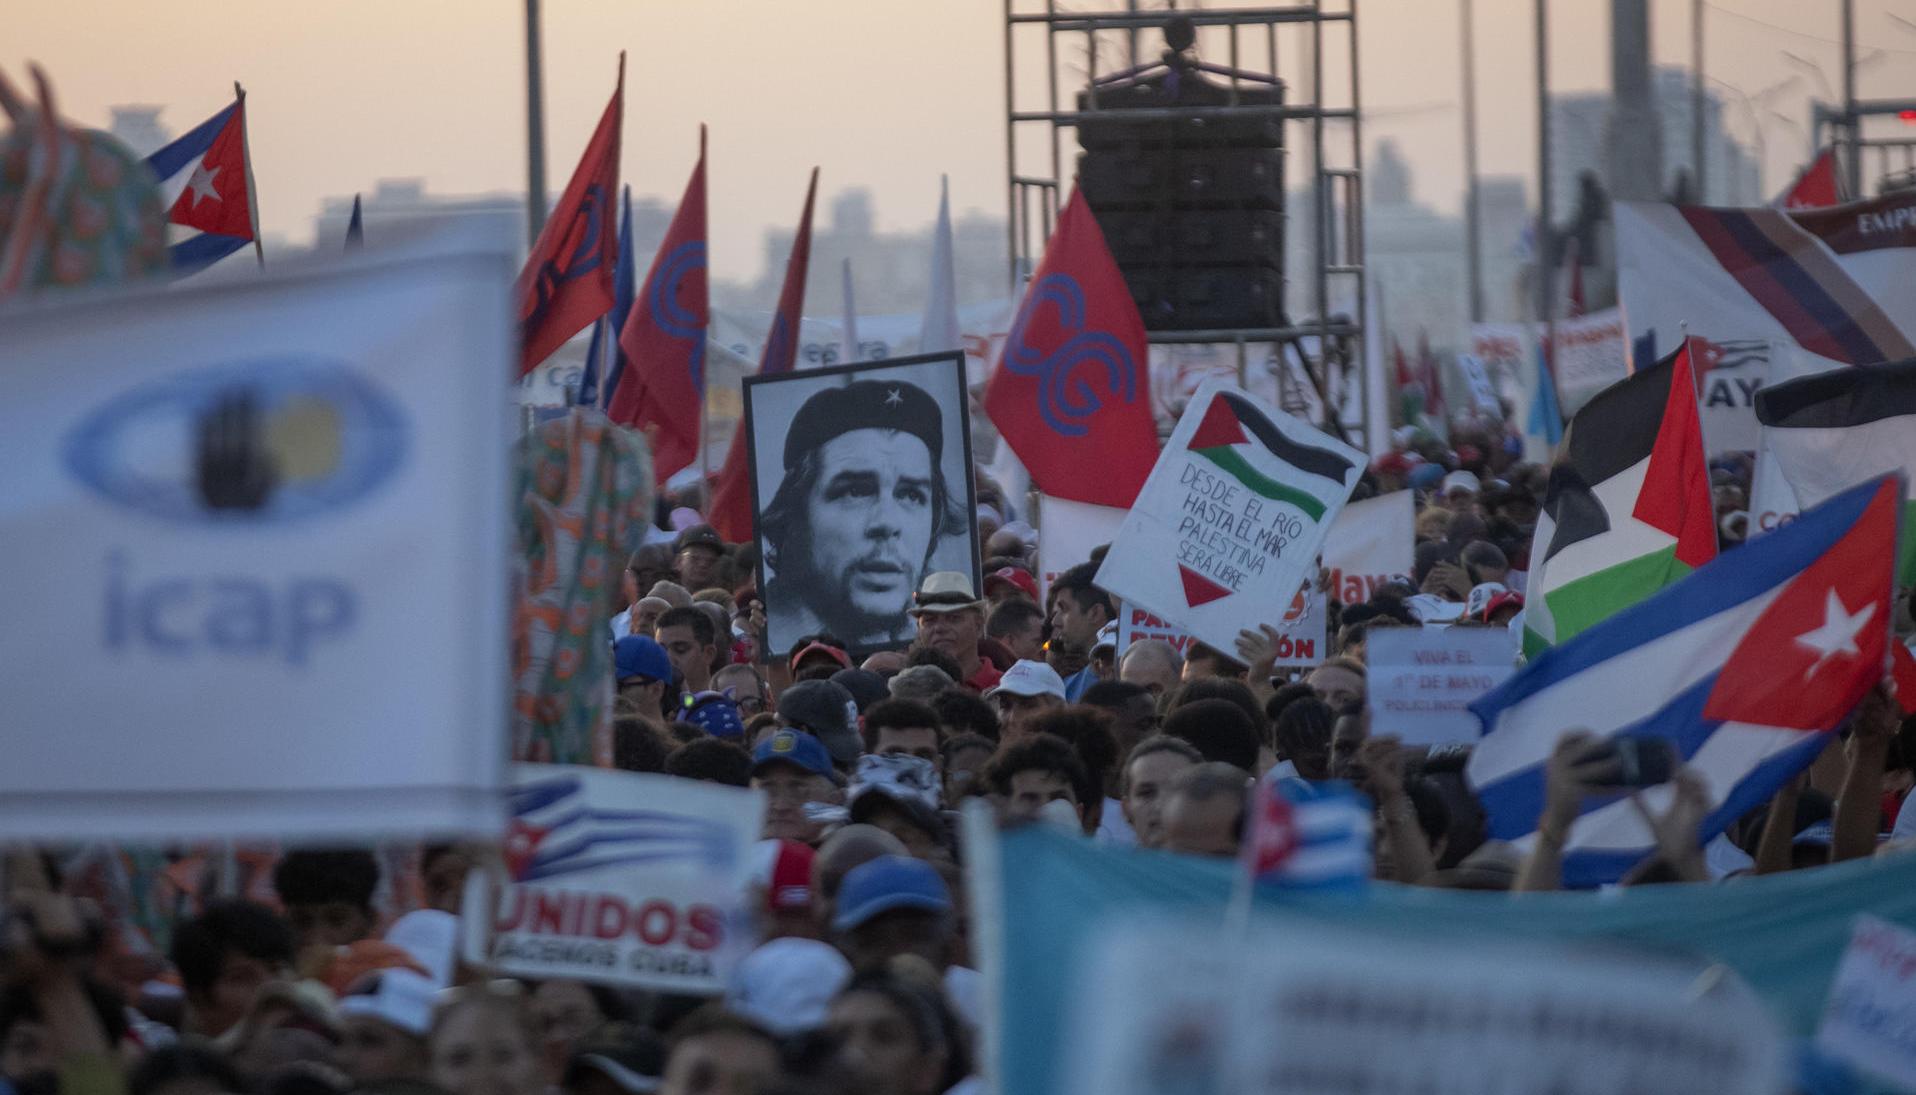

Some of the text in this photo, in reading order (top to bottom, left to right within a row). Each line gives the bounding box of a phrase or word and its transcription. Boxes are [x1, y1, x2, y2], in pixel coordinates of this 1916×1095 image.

[1706, 377, 1762, 407] AY
[1180, 463, 1303, 539] DESDE EL RÍO
[1178, 516, 1266, 575] PALESTINA
[1183, 493, 1288, 558] HASTA EL MAR
[1213, 560, 1248, 592] LIBRE
[103, 549, 359, 670] icap
[1414, 650, 1474, 664] VIVA EL
[1420, 675, 1441, 689] DE
[1448, 675, 1493, 689] MAYO
[491, 884, 726, 951] UNIDOS
[627, 948, 716, 979] CUBA
